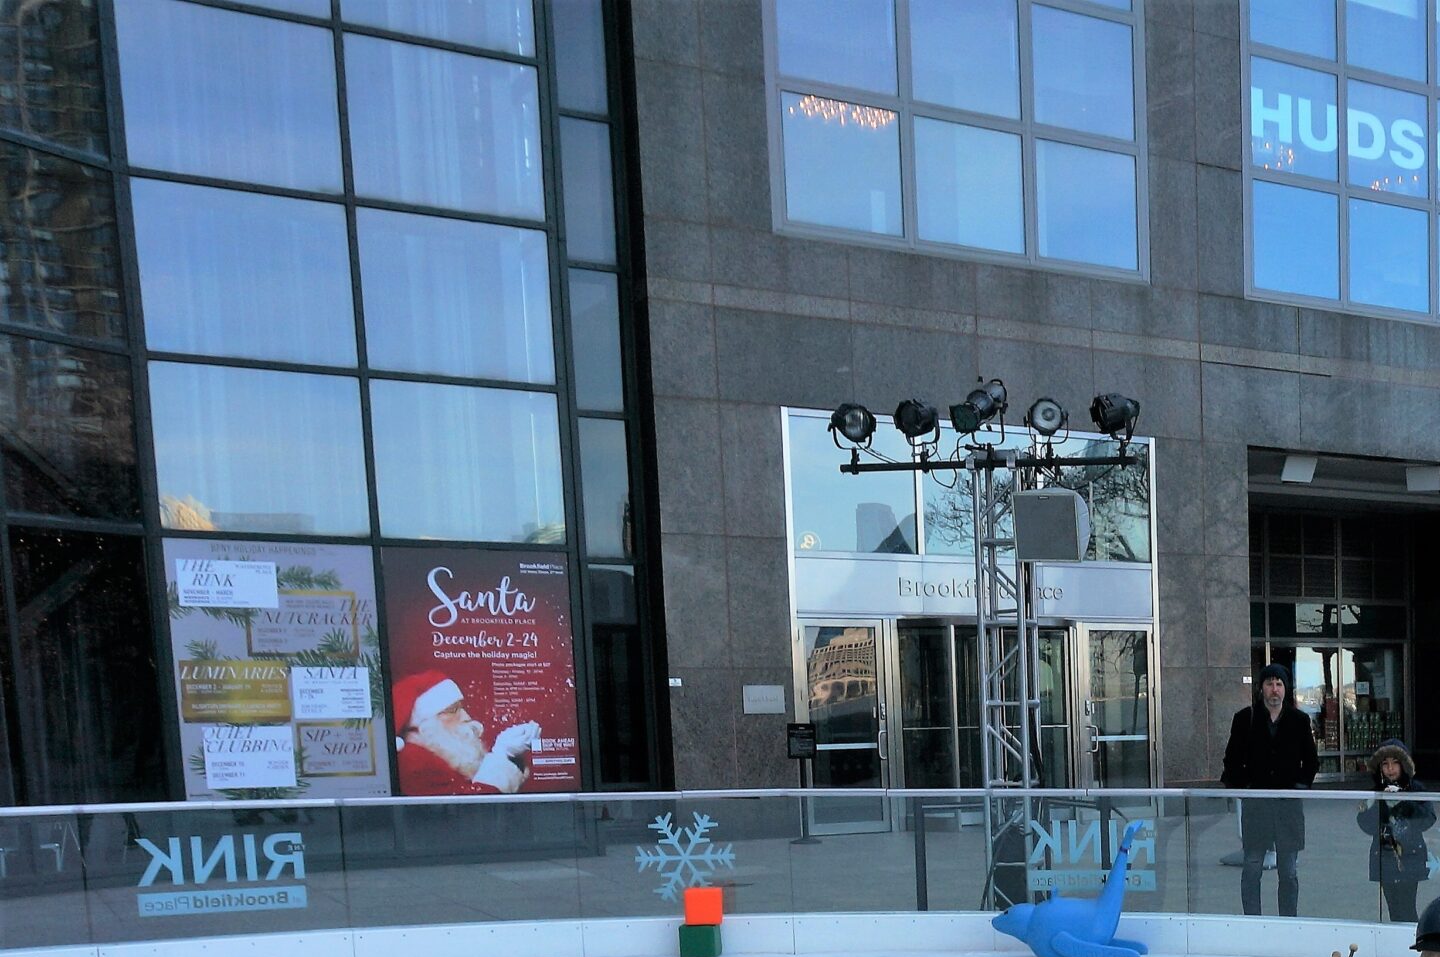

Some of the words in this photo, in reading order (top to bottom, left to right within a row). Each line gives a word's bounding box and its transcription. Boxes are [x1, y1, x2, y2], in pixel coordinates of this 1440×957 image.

[192, 572, 236, 588] RINK
[427, 566, 536, 628] Santa
[263, 611, 373, 625] NUTCRACKER
[432, 630, 504, 648] December
[506, 631, 539, 648] 2-24
[433, 651, 466, 660] Capture
[467, 651, 479, 659] the
[481, 651, 511, 660] holiday
[511, 652, 538, 660] magic!
[180, 666, 288, 680] LUMINARIES
[303, 667, 359, 679] SANTA
[304, 729, 331, 743] SIP
[205, 738, 293, 753] CLUBBING
[322, 742, 368, 756] SHOP
